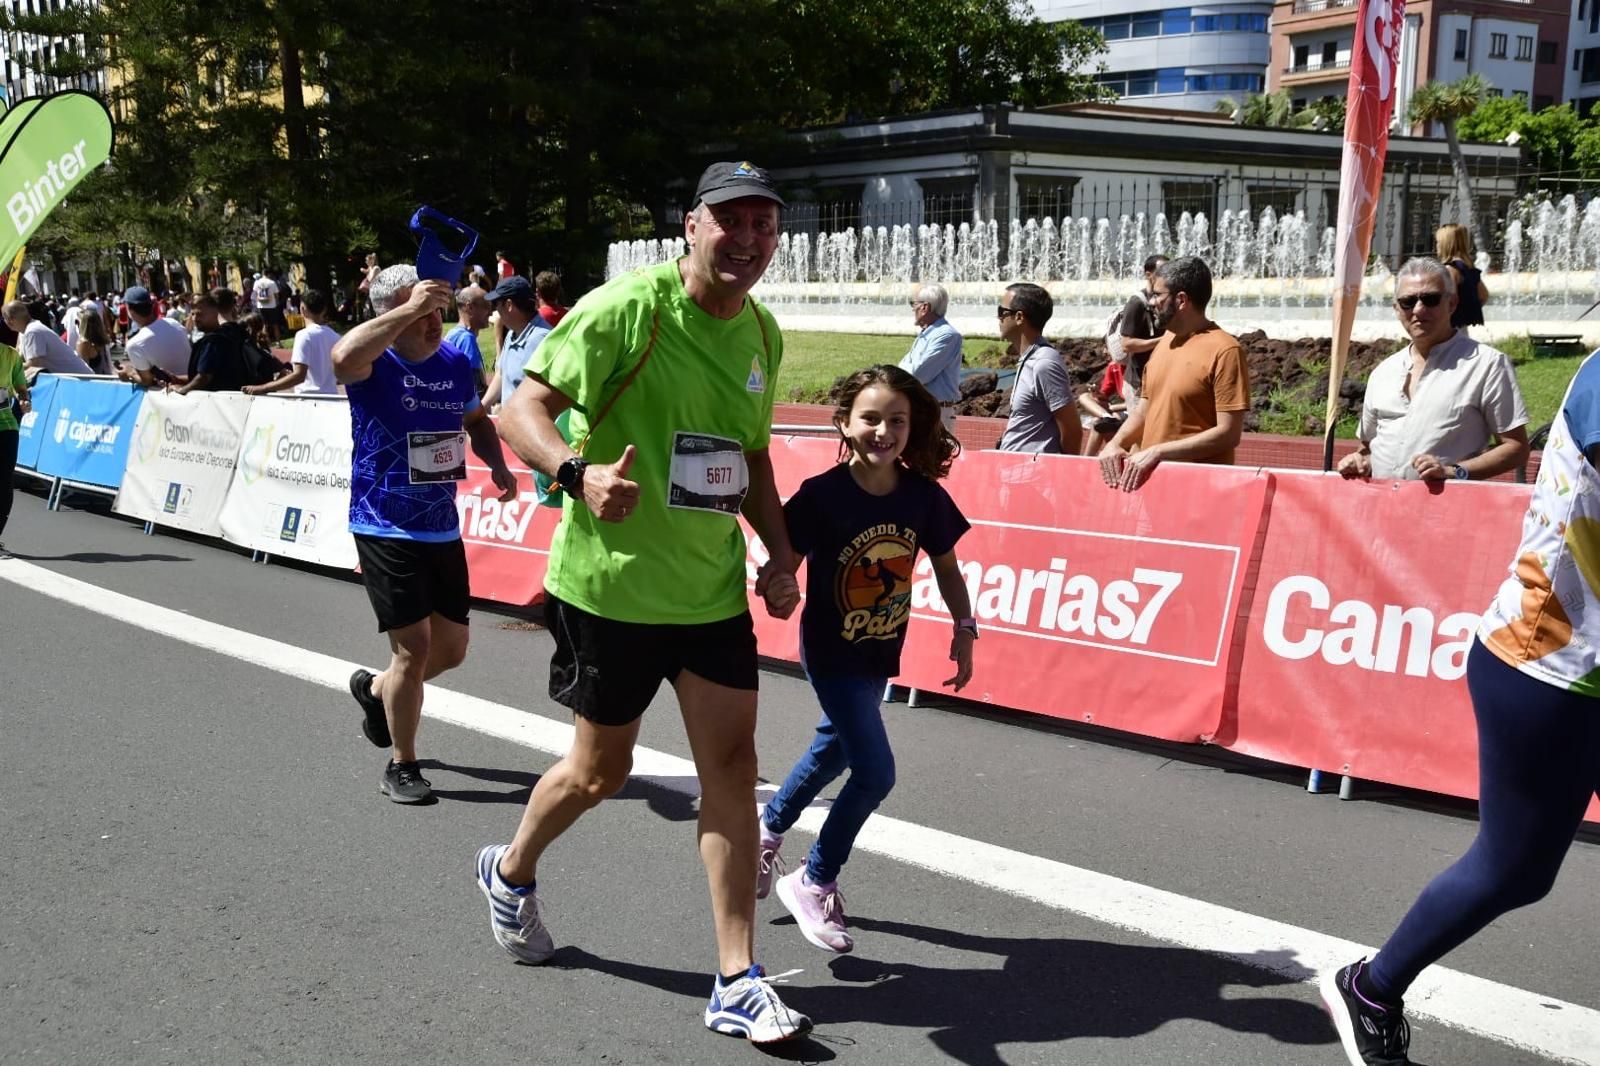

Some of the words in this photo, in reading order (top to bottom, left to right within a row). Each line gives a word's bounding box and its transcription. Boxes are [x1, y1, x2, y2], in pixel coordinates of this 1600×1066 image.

[6, 139, 87, 236] Binter
[195, 451, 206, 464] del
[314, 472, 328, 486] del
[706, 467, 732, 485] 5677
[838, 546, 854, 565] NO
[851, 523, 900, 549] PUEDO,
[1263, 575, 1482, 681] Cana
